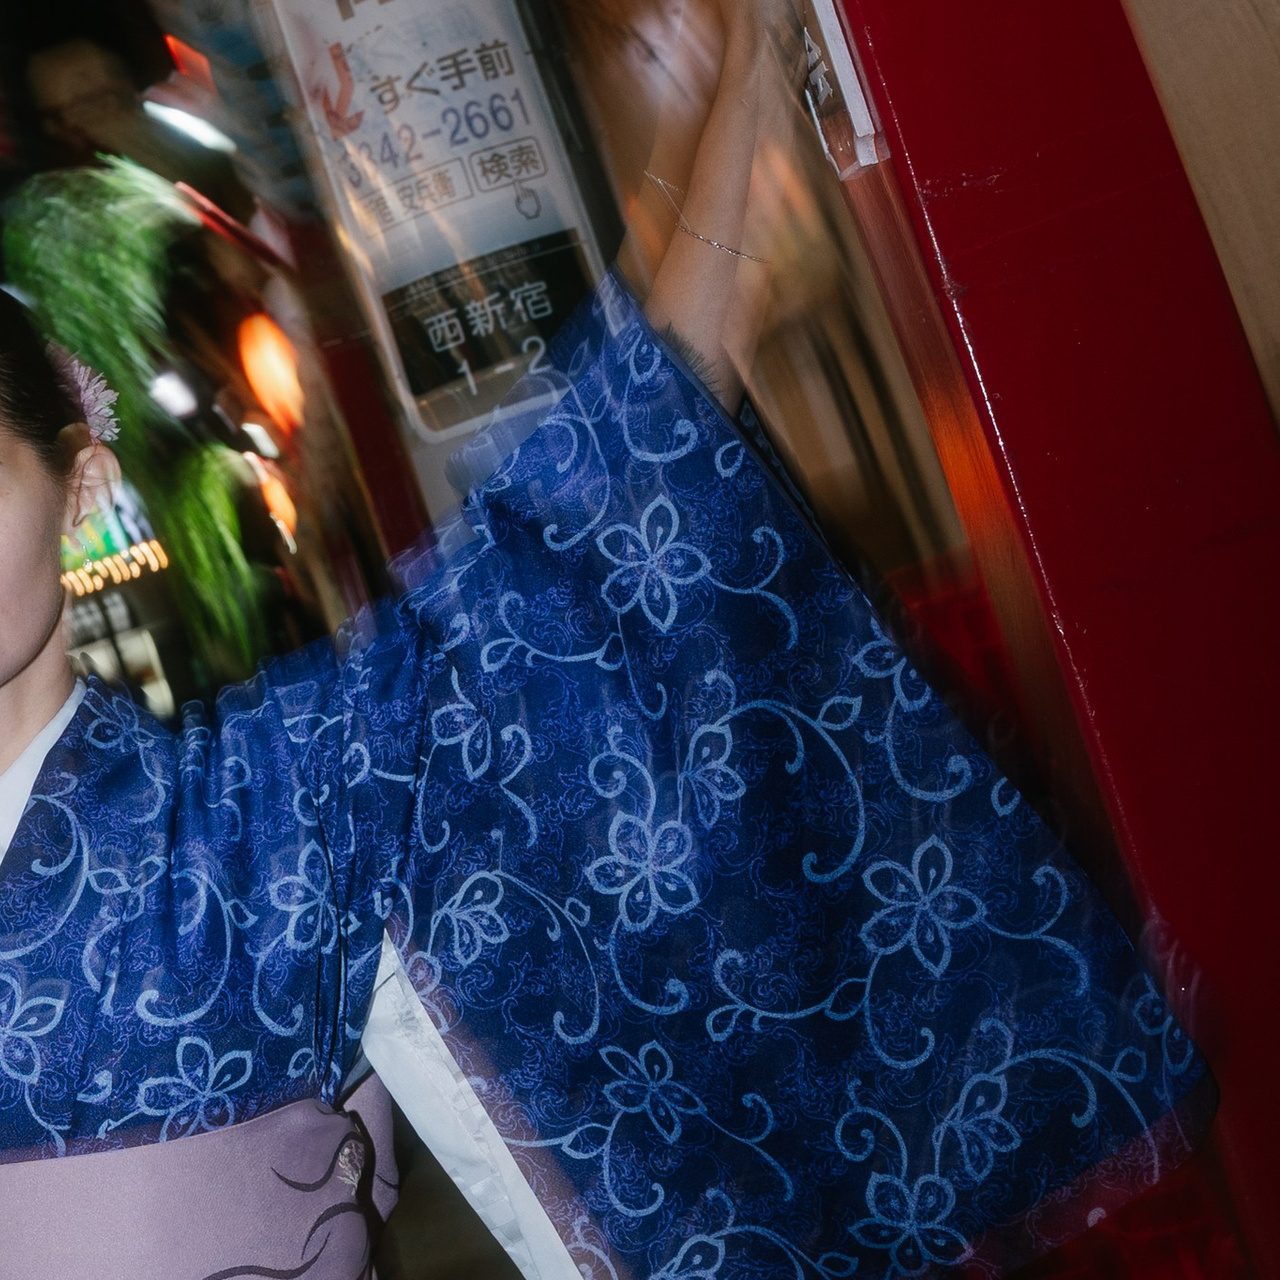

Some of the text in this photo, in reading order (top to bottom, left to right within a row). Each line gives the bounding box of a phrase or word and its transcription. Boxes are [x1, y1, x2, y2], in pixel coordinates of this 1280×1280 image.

[369, 39, 515, 115] すぐ手前
[477, 143, 540, 184] 検索
[424, 280, 553, 353] 西新宿
